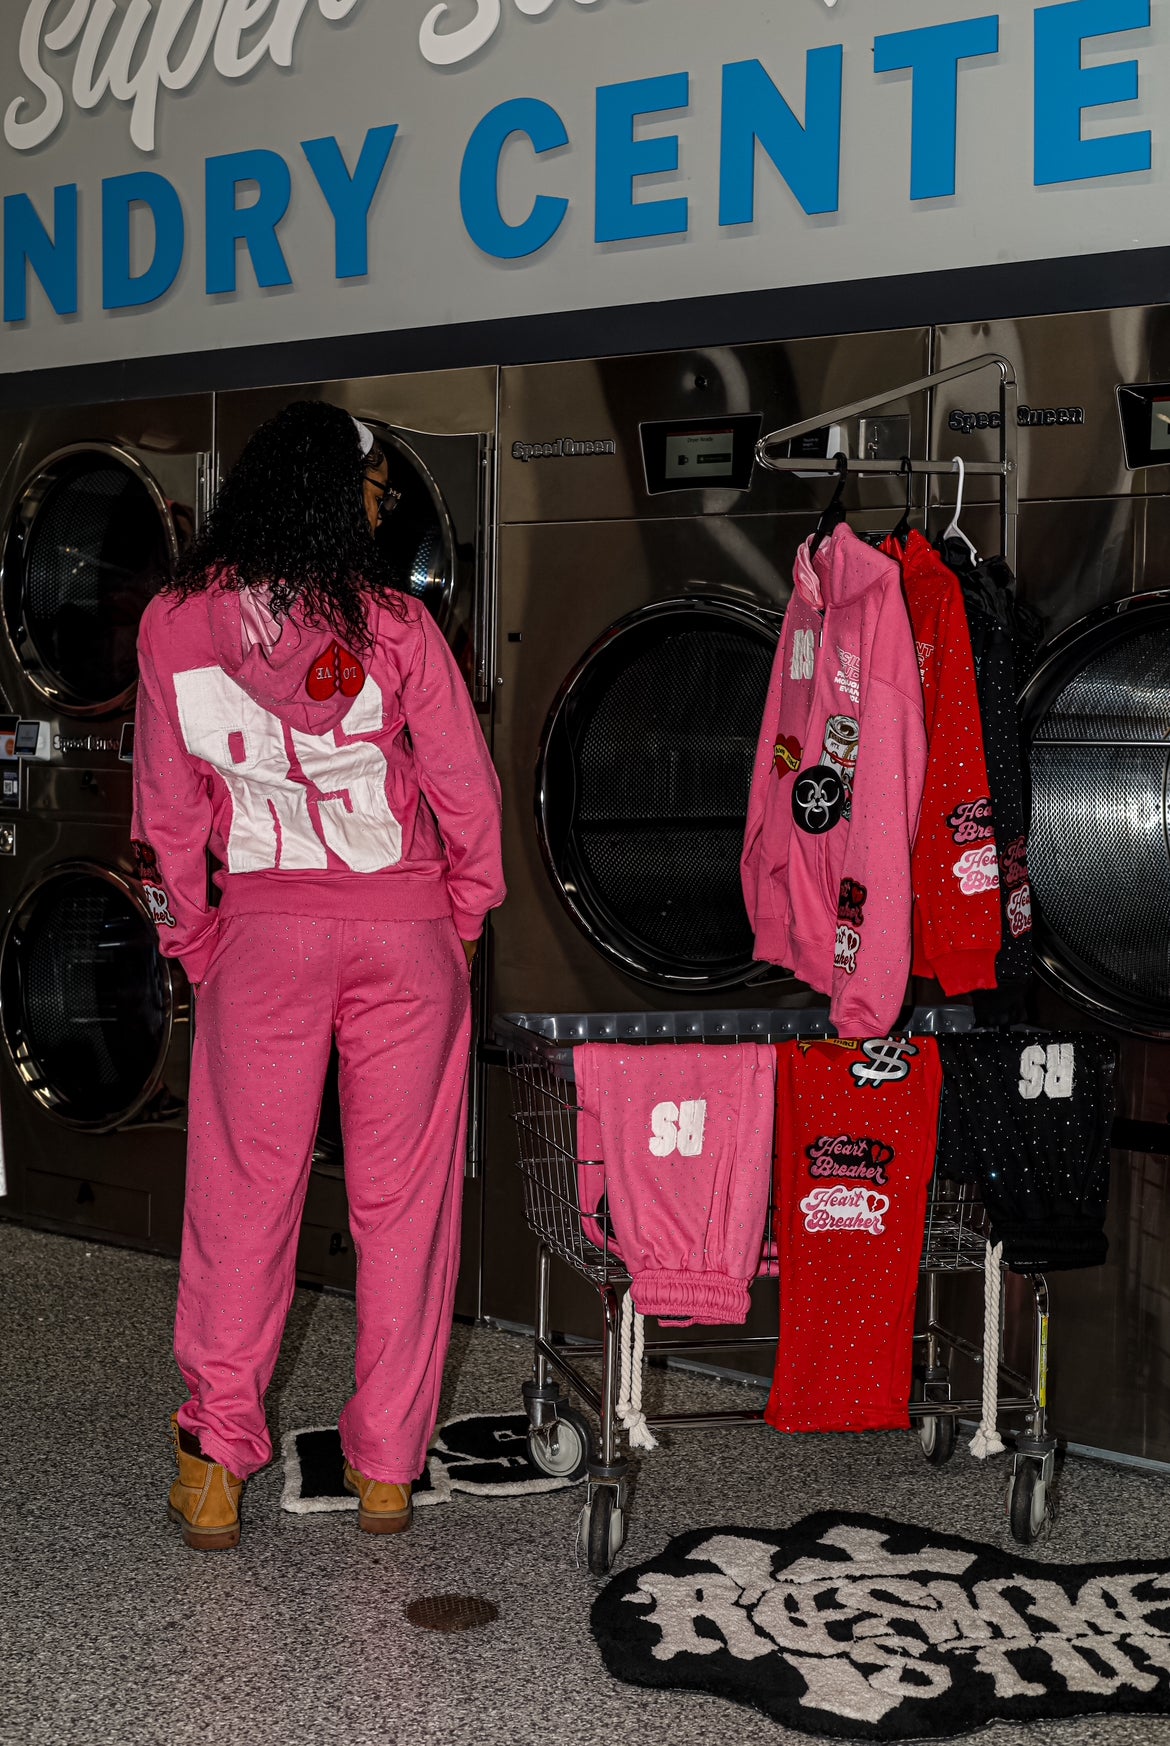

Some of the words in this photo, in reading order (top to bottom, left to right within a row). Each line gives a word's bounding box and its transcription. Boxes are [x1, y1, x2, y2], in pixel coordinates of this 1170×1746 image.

[950, 409, 1002, 434] Spee
[512, 438, 564, 462] Speed
[563, 437, 617, 456] Queen
[950, 799, 993, 826] Hea
[958, 846, 999, 875] Hea
[809, 1135, 869, 1158] Heart
[810, 1156, 886, 1185] Breaker
[805, 1187, 864, 1212] Heart
[806, 1209, 883, 1234] Breaker
